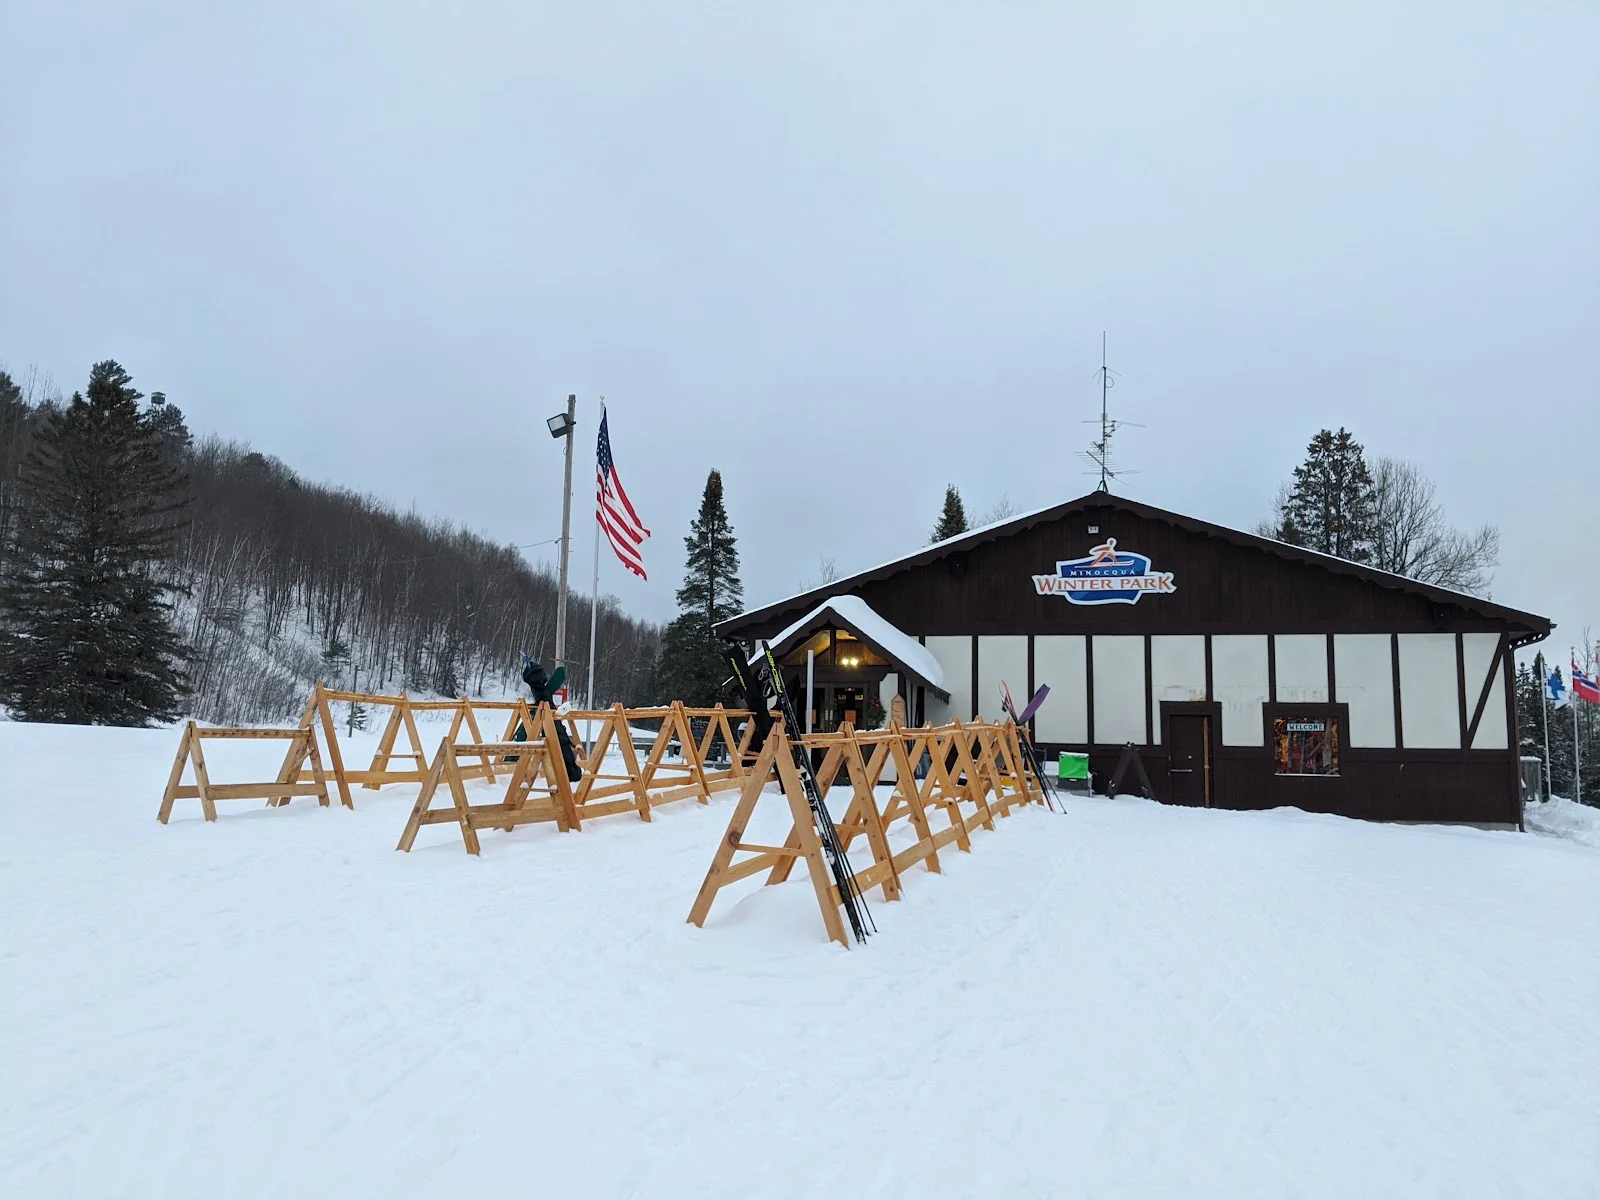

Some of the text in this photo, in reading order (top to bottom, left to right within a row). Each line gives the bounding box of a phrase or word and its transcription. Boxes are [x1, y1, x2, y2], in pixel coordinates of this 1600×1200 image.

[1070, 569, 1136, 577] MINOCQUA
[1036, 575, 1173, 593] WINTER PARK
